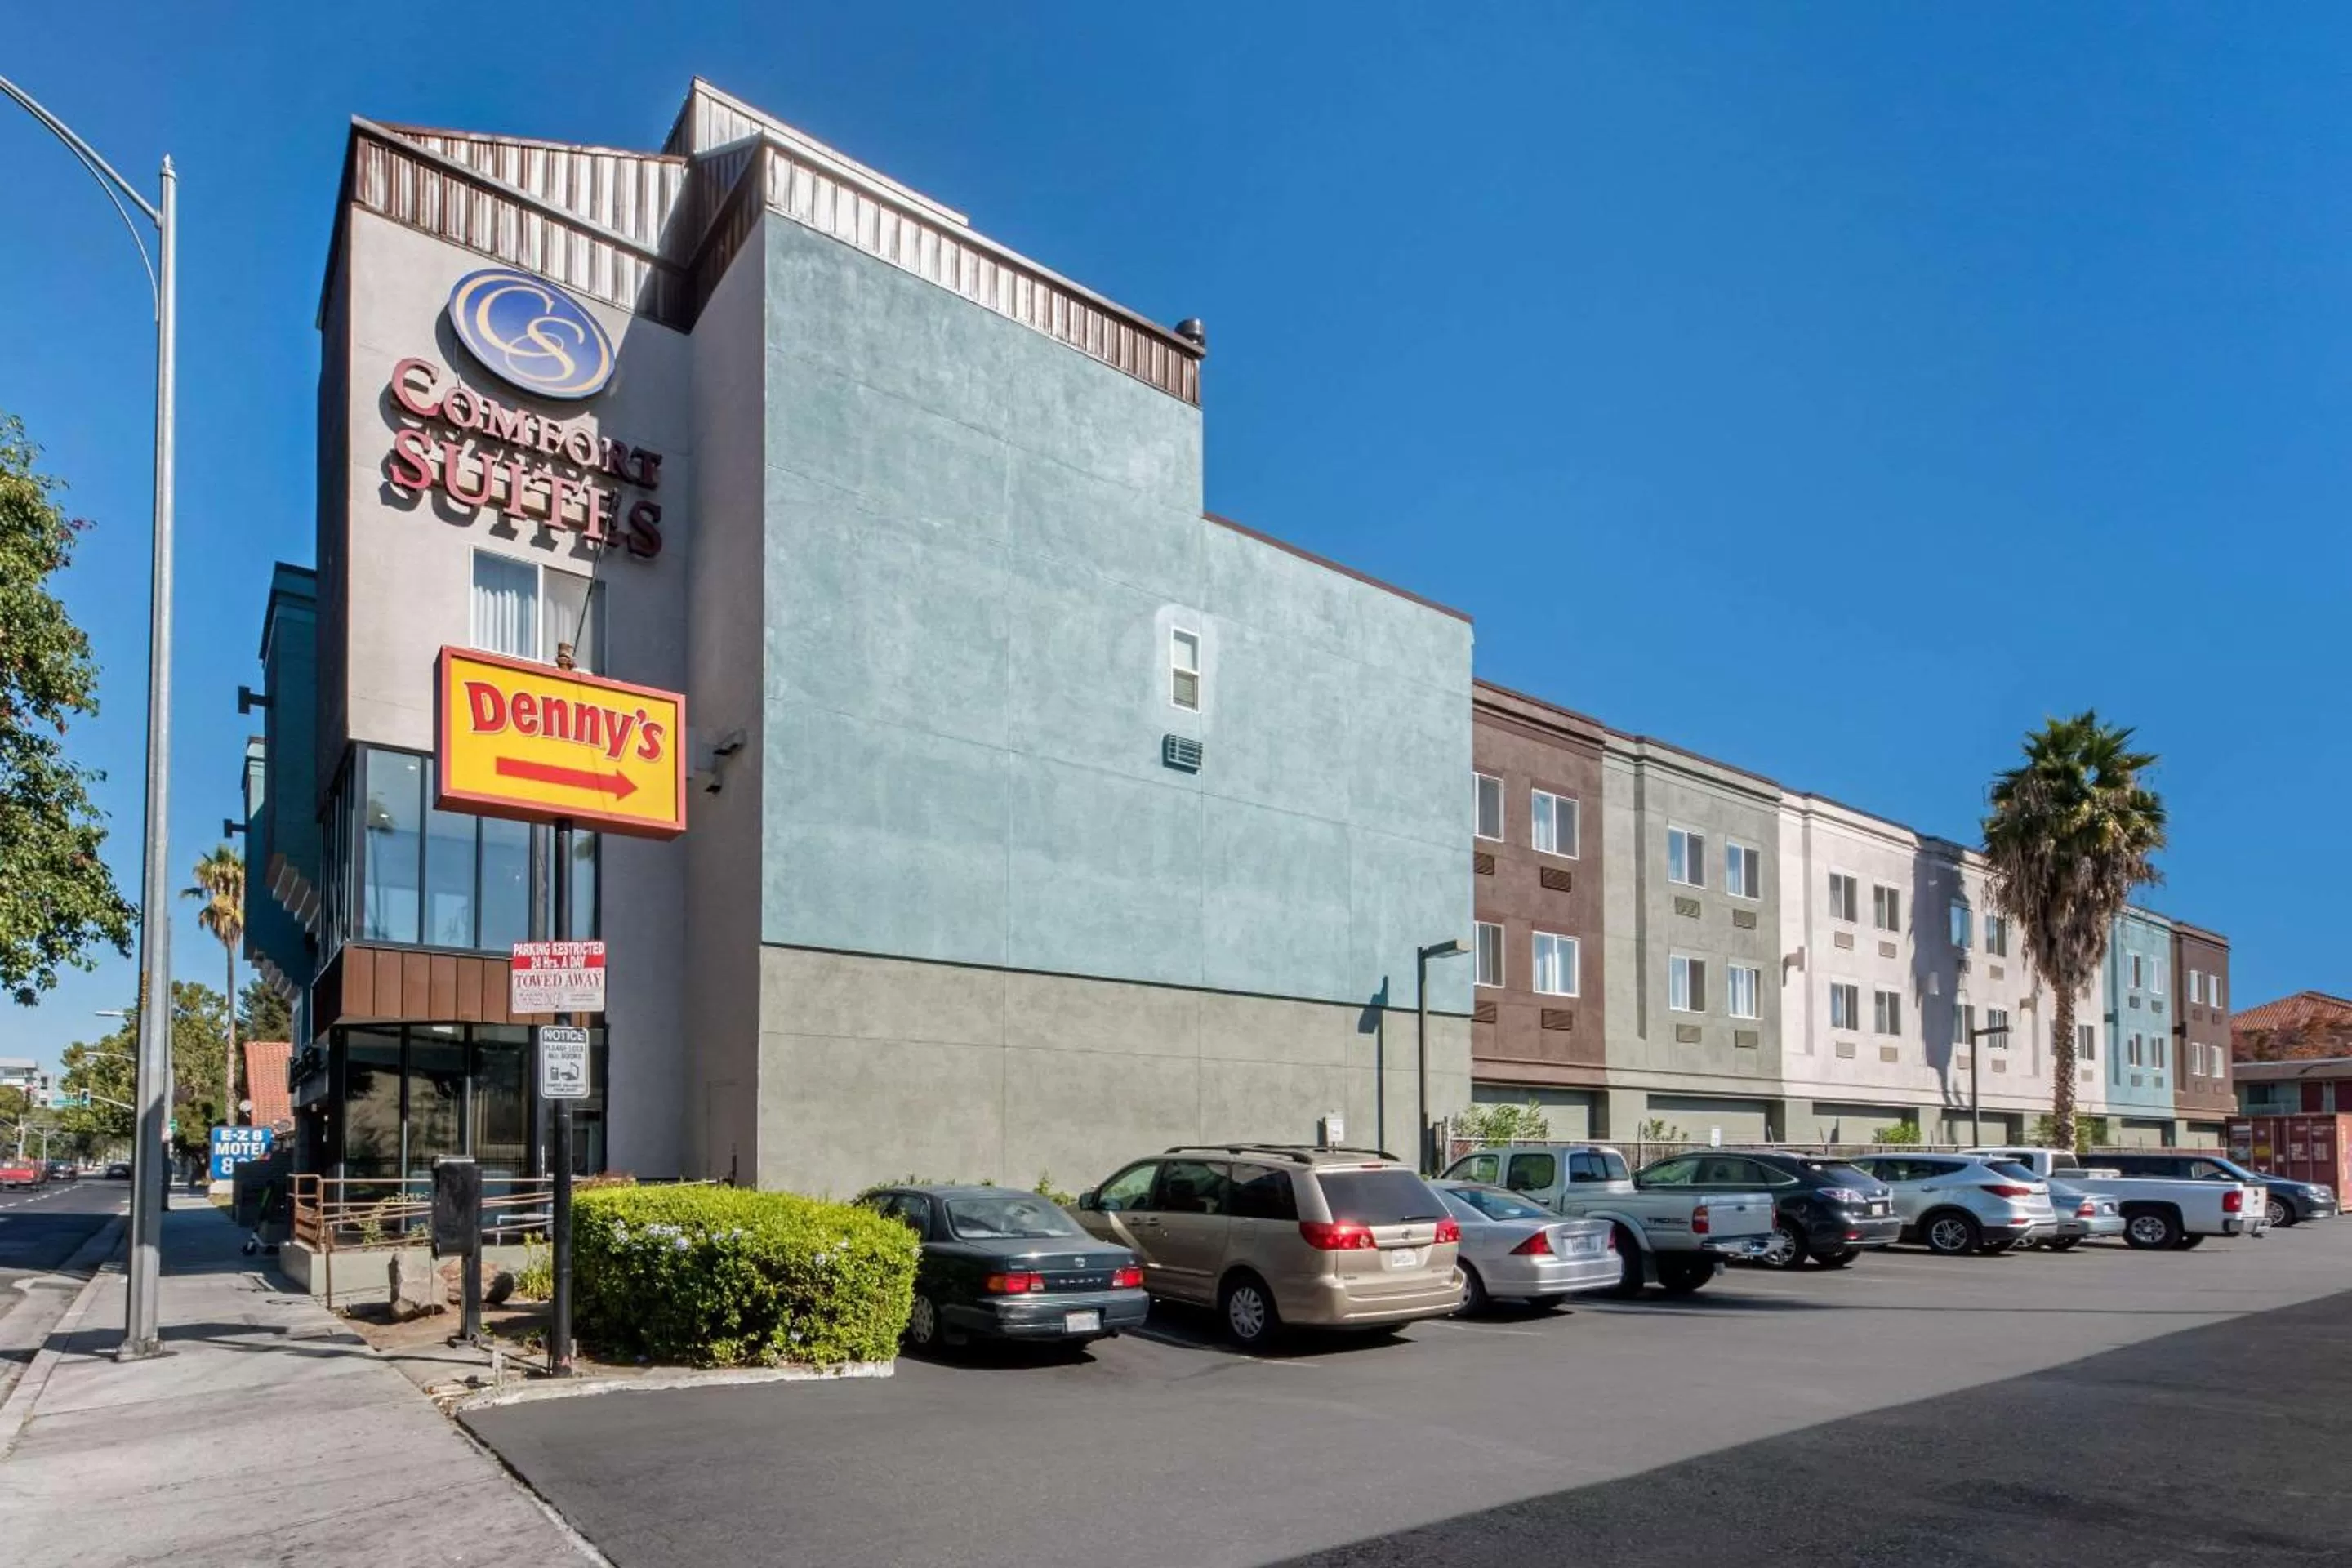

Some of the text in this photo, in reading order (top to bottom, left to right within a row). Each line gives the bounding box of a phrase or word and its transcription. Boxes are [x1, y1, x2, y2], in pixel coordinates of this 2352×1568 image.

[390, 357, 663, 490] COMFORT
[389, 429, 663, 557] SUITES
[464, 680, 666, 761] Denny's
[514, 942, 604, 956] PARKING RESTRICTED
[561, 956, 569, 968] A
[515, 973, 601, 987] TOWED AWAY
[544, 1030, 586, 1040] NOTICE
